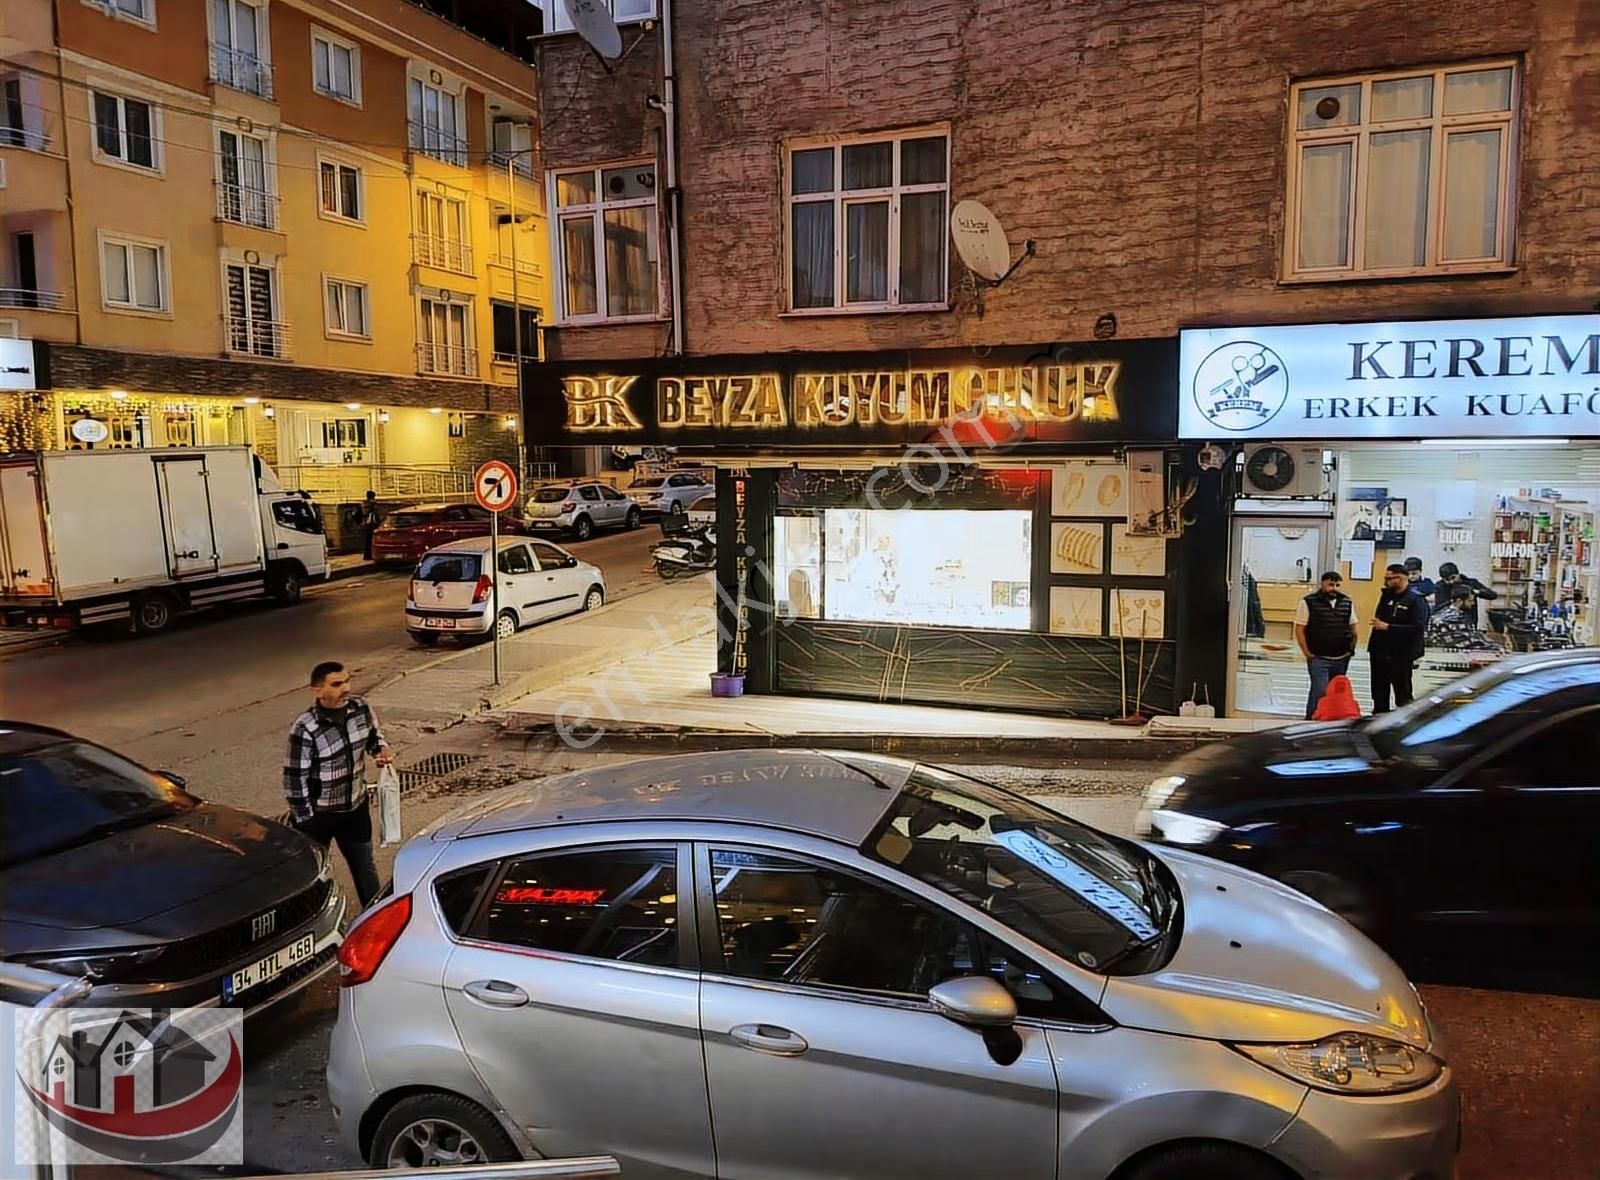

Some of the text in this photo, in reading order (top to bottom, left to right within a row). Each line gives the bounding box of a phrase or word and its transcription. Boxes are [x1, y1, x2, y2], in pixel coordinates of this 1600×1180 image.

[1346, 334, 1600, 380] KEREM
[560, 374, 644, 430] BK
[656, 374, 788, 428] BEYZA
[1303, 394, 1440, 419] ERKEK
[735, 480, 747, 545] BEYZA
[252, 909, 277, 941] FIAT
[234, 937, 311, 991] 34 HTL 468
